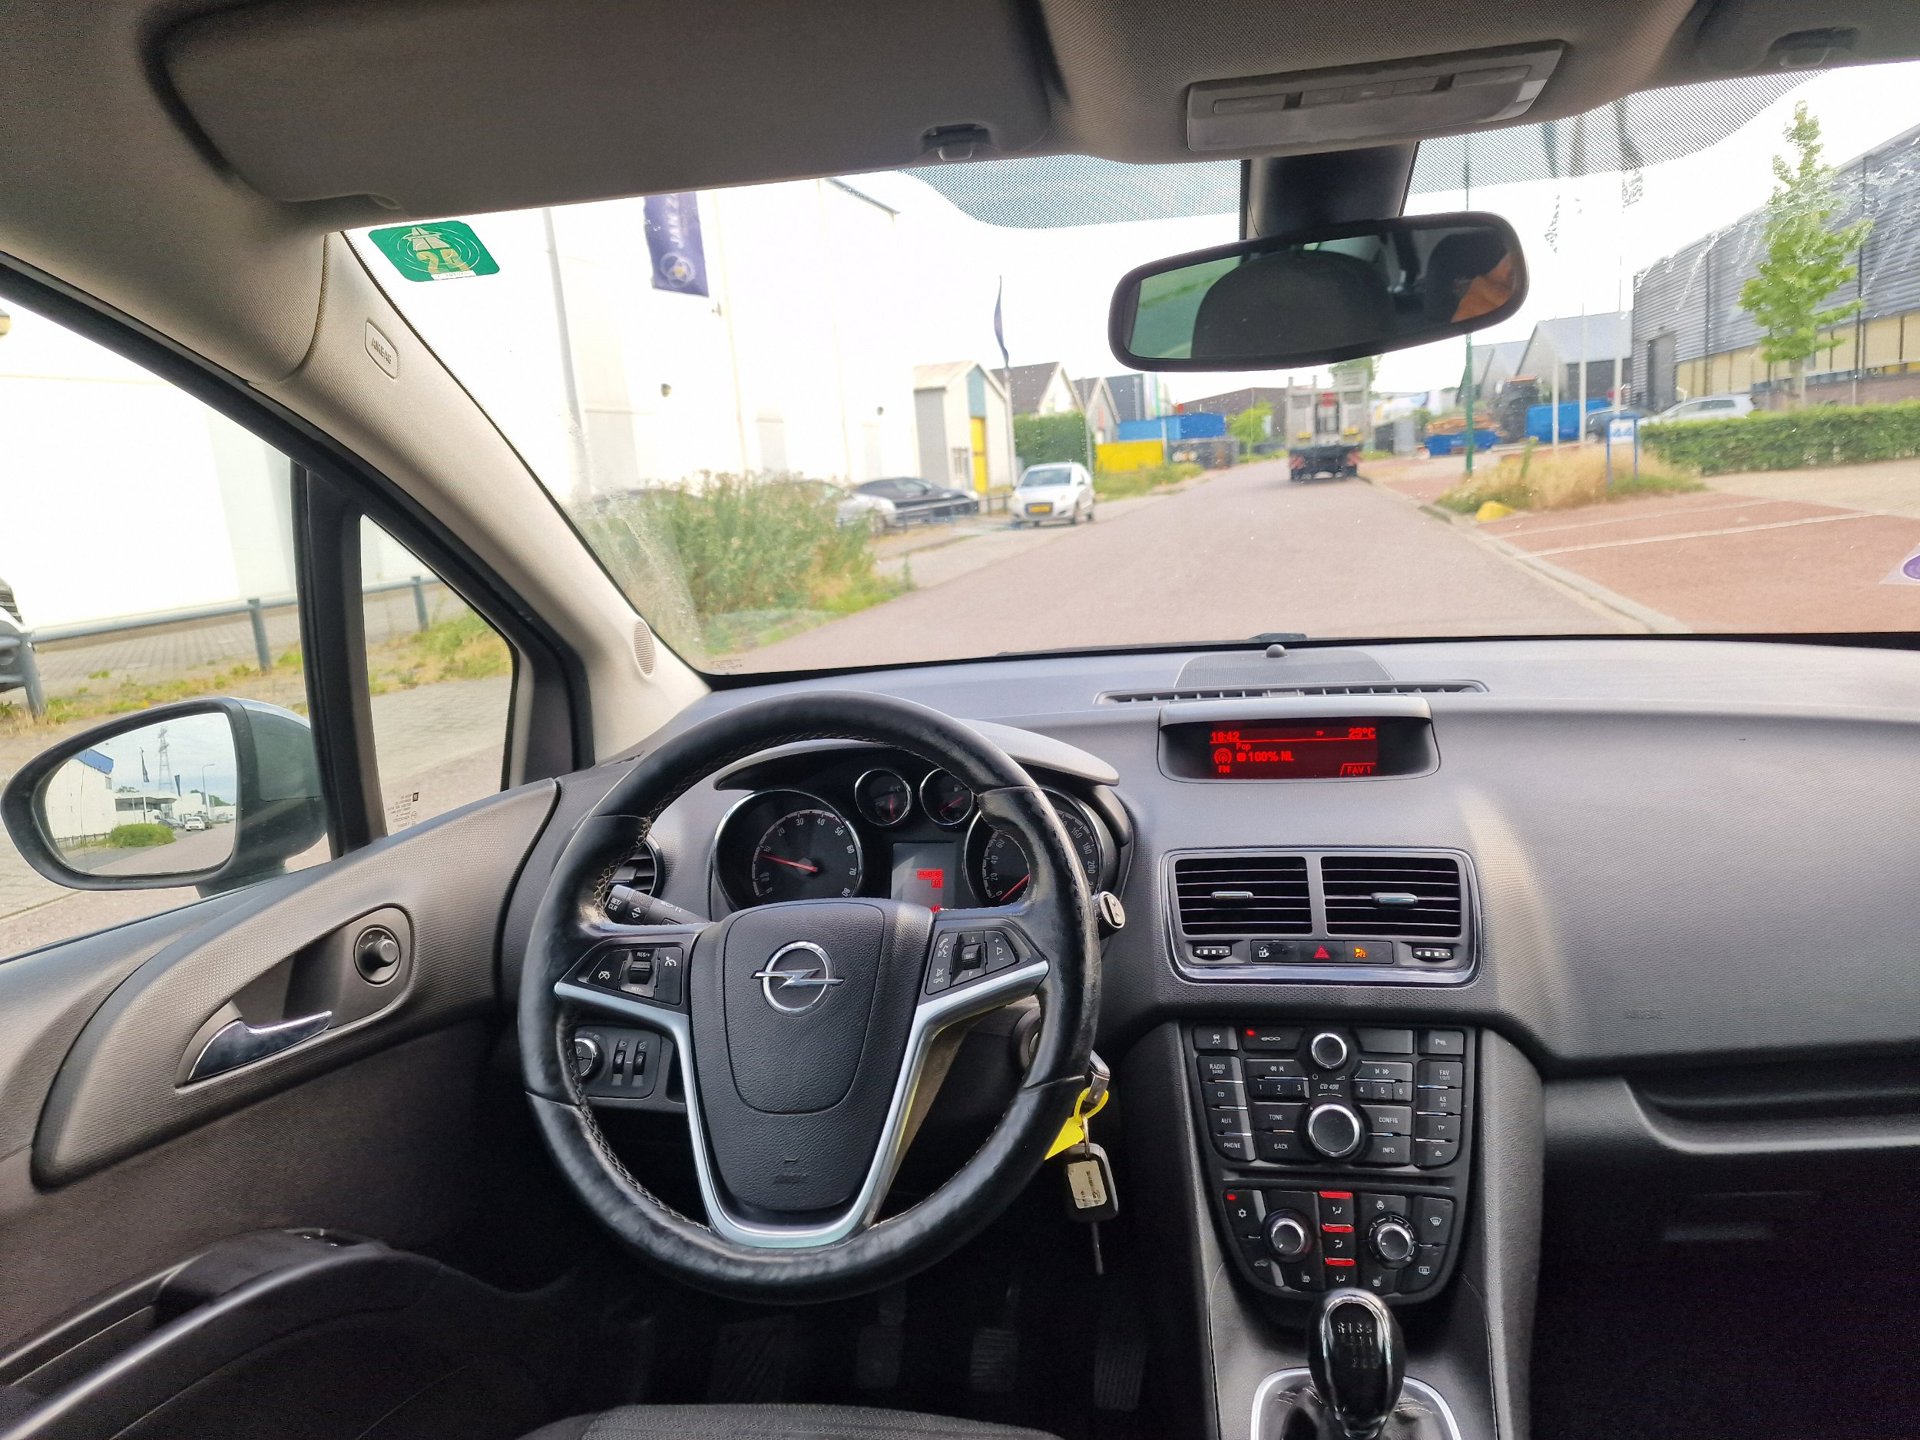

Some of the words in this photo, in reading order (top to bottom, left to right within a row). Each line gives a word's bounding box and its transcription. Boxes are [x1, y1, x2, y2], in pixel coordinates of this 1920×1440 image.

[1347, 765, 1364, 775] FAV
[795, 818, 804, 826] 30
[817, 818, 826, 826] 40
[834, 826, 844, 836] 50
[1082, 842, 1093, 855] 180
[849, 867, 857, 876] 70
[1087, 860, 1096, 874] 200
[1378, 1116, 1399, 1124] CONFIG
